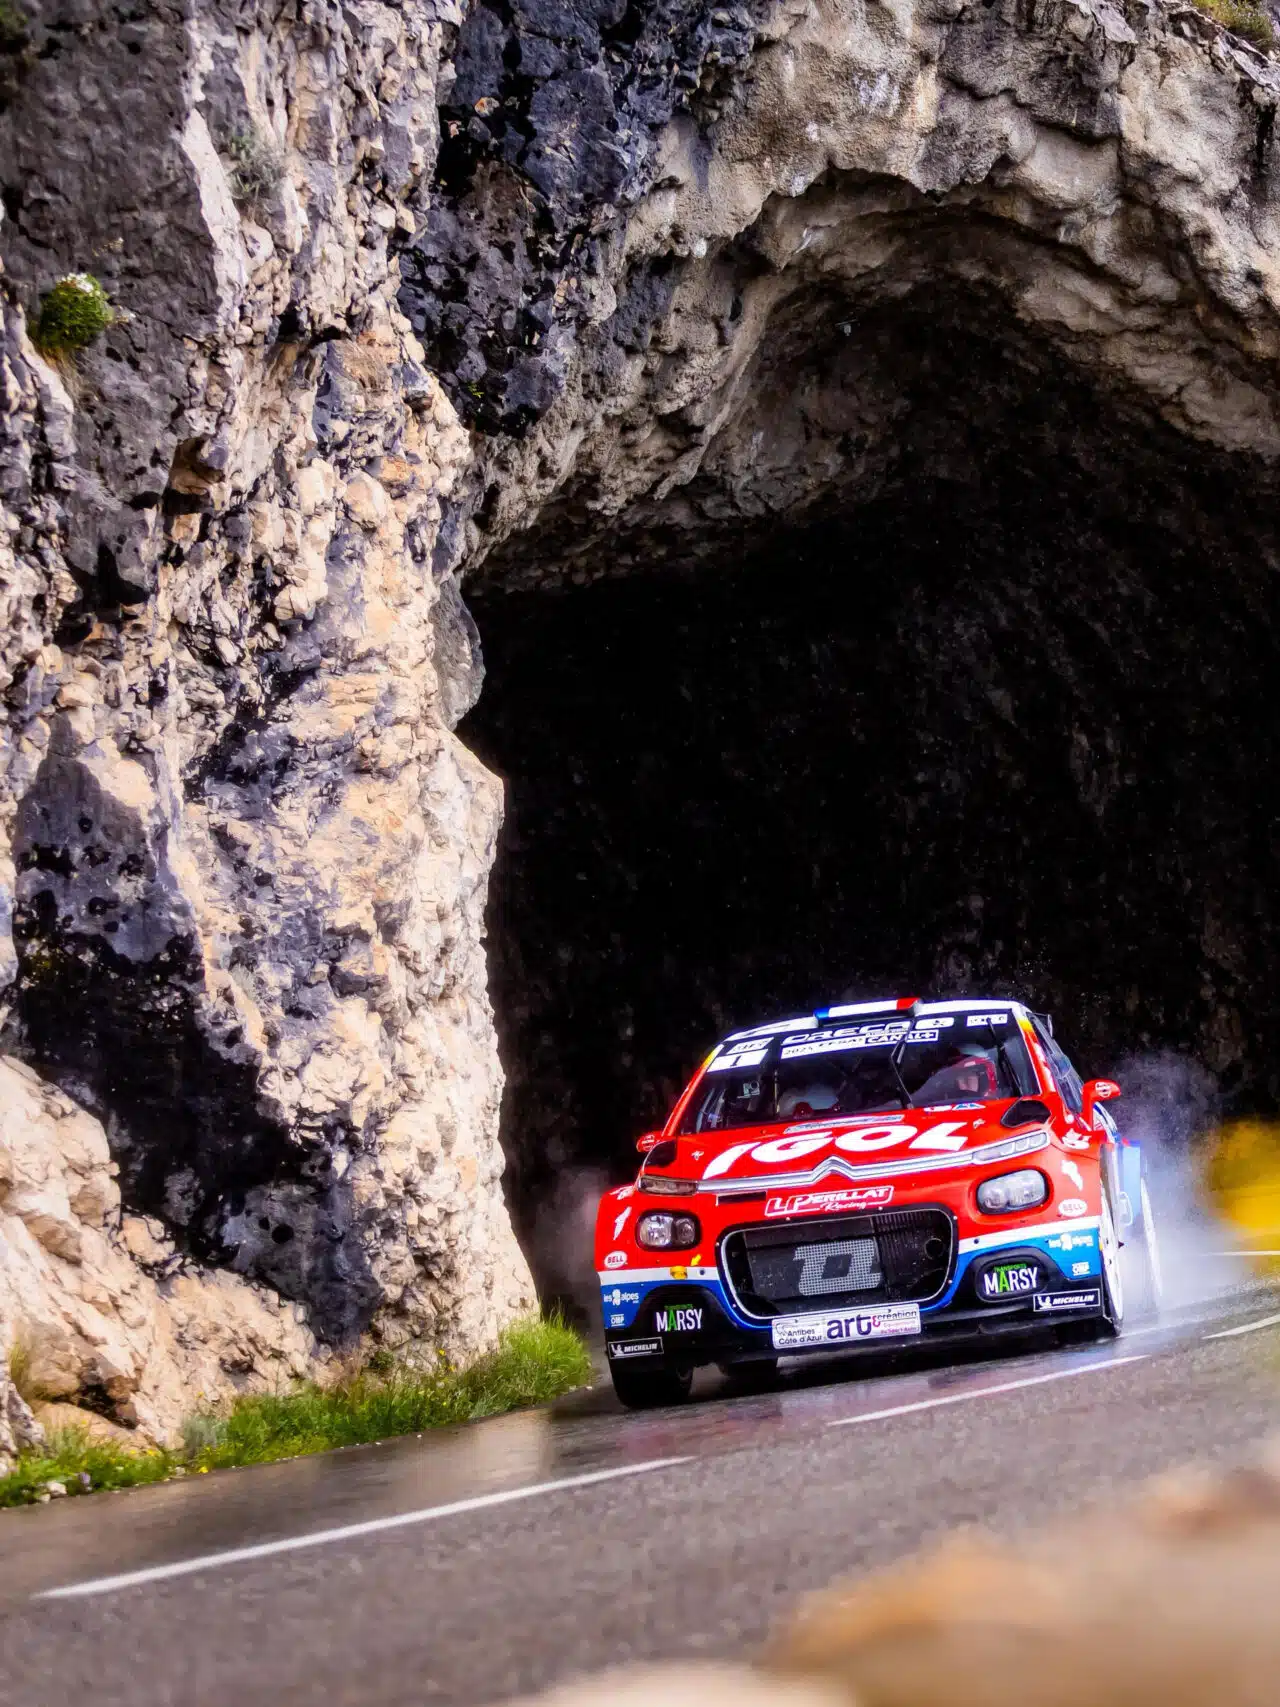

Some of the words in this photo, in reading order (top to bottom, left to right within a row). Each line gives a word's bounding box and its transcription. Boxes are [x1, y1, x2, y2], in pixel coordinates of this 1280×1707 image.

[607, 1255, 624, 1264] BELL
[983, 1266, 1038, 1295] MARSY
[1052, 1294, 1095, 1305] MICHELIN
[655, 1308, 703, 1333] MARSY
[787, 1328, 815, 1337] Antibes
[826, 1314, 872, 1340] art
[623, 1343, 658, 1353] MICHELIN
